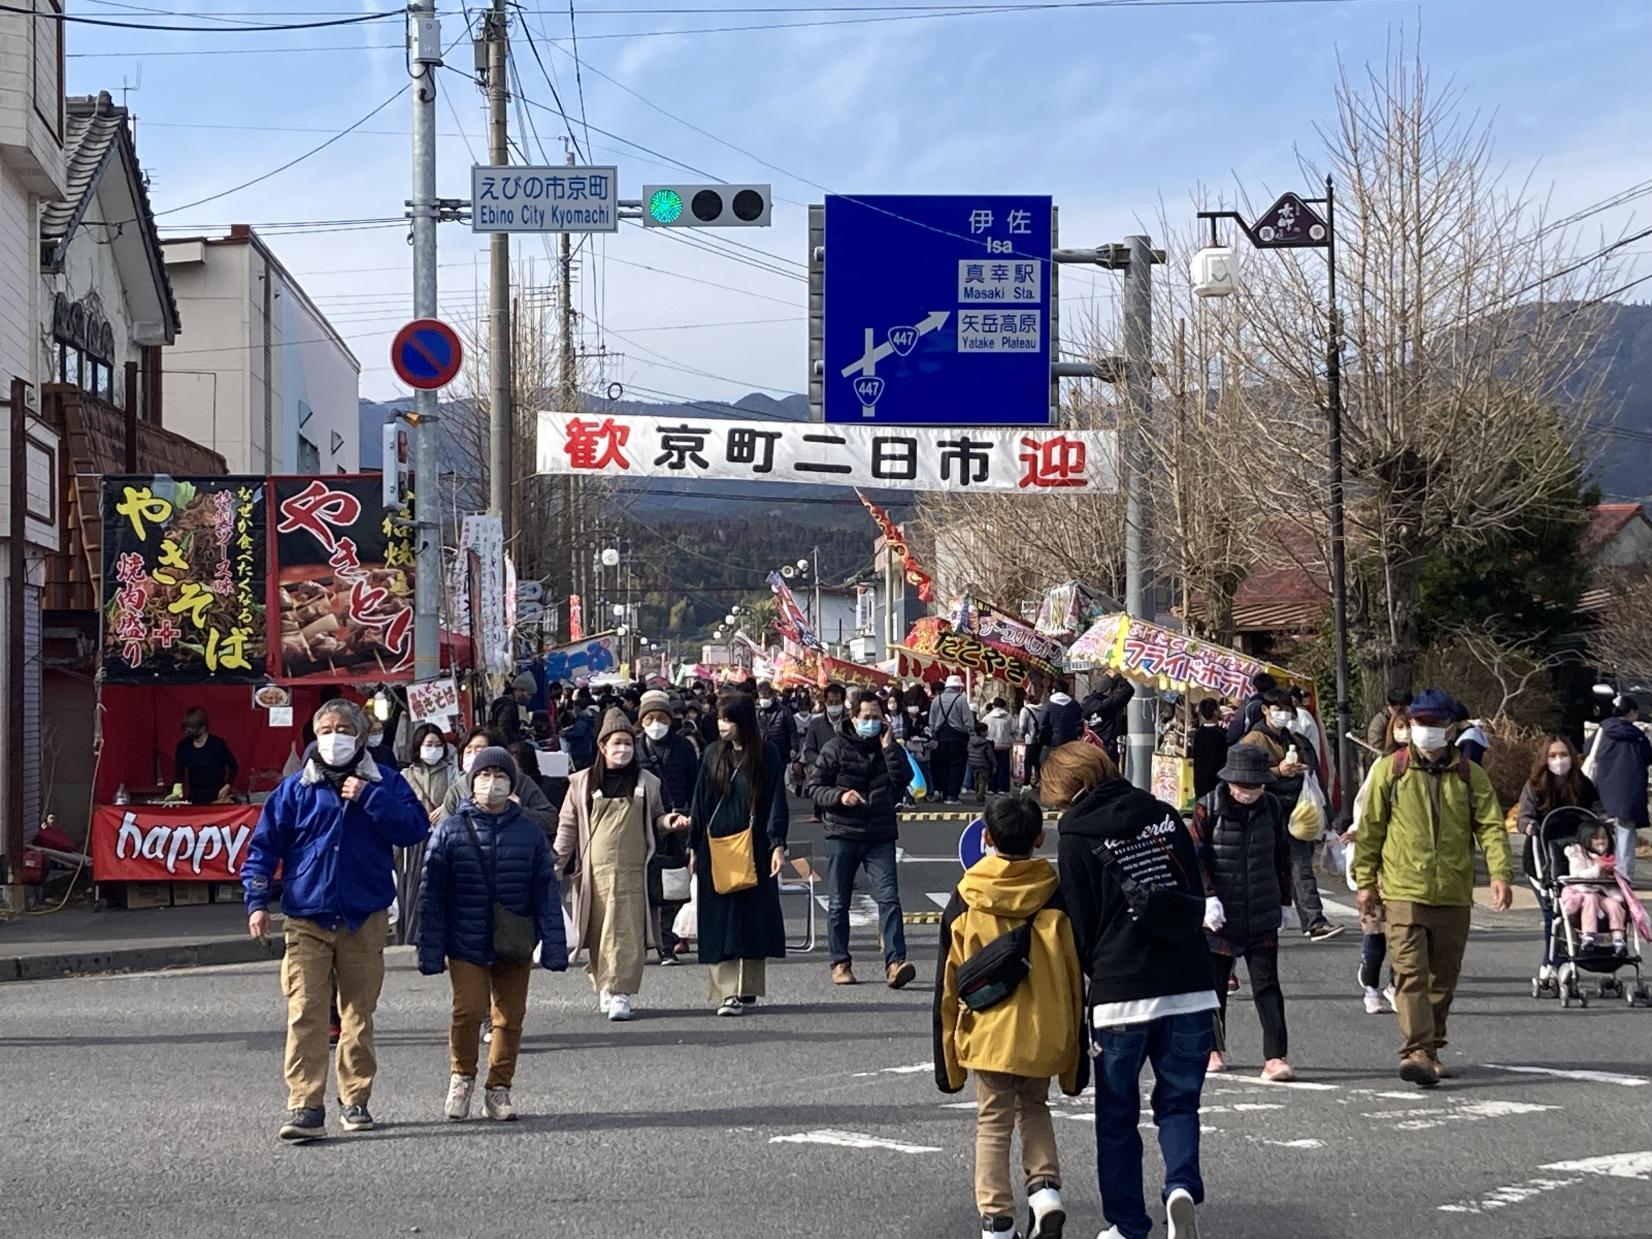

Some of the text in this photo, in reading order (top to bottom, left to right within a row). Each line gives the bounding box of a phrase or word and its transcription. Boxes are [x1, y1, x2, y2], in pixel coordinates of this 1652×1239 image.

[480, 175, 609, 201] えびの市京町
[480, 205, 609, 228] Ebino City Kyomachi
[986, 236, 1013, 254] Isa
[964, 264, 1035, 284] 真幸駅
[963, 286, 1035, 300] Masaki Sta.
[962, 314, 1037, 334] 矢岳高原
[892, 331, 913, 346] 447
[962, 336, 1037, 350] Yatake Plateau
[858, 381, 879, 396] 447
[116, 486, 253, 672] やきそば
[115, 551, 148, 670] 焼肉盛り
[115, 811, 251, 874] happy
